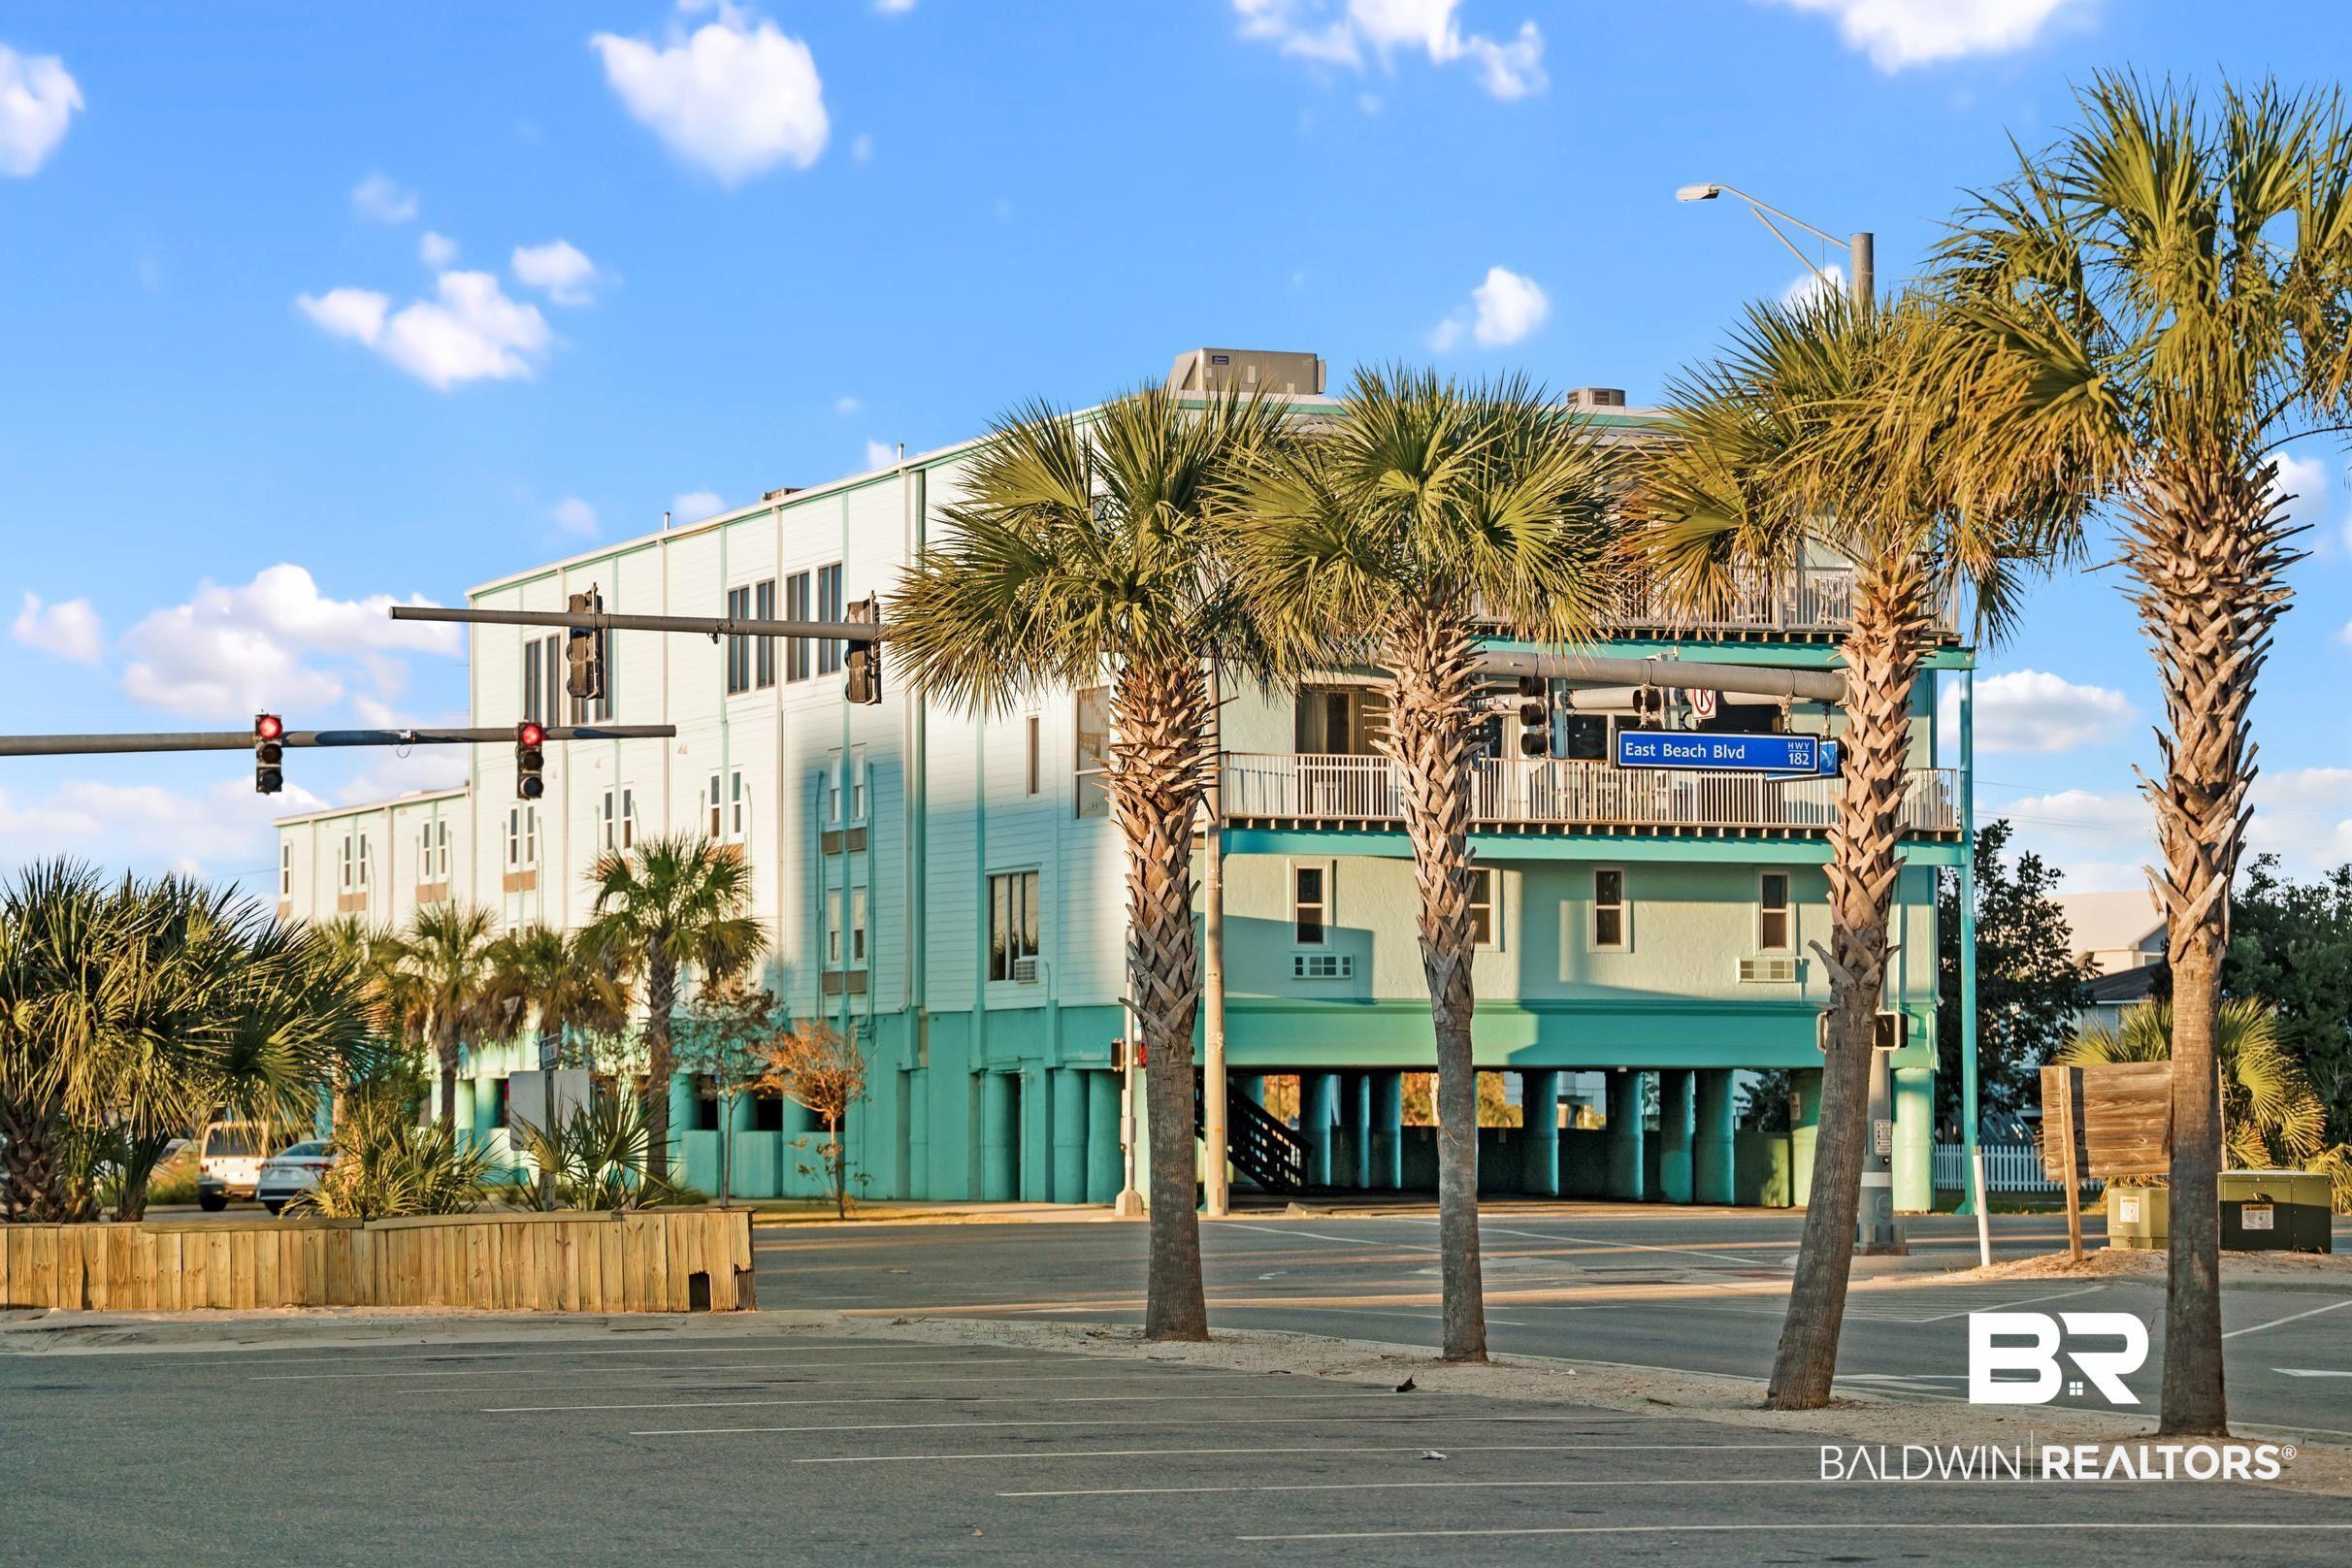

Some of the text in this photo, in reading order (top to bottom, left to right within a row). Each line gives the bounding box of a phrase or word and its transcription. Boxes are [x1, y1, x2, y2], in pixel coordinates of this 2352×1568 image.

[1625, 742, 1746, 759] East Beach Blvd
[1787, 741, 1810, 750] HWY
[1788, 752, 1810, 766] 182
